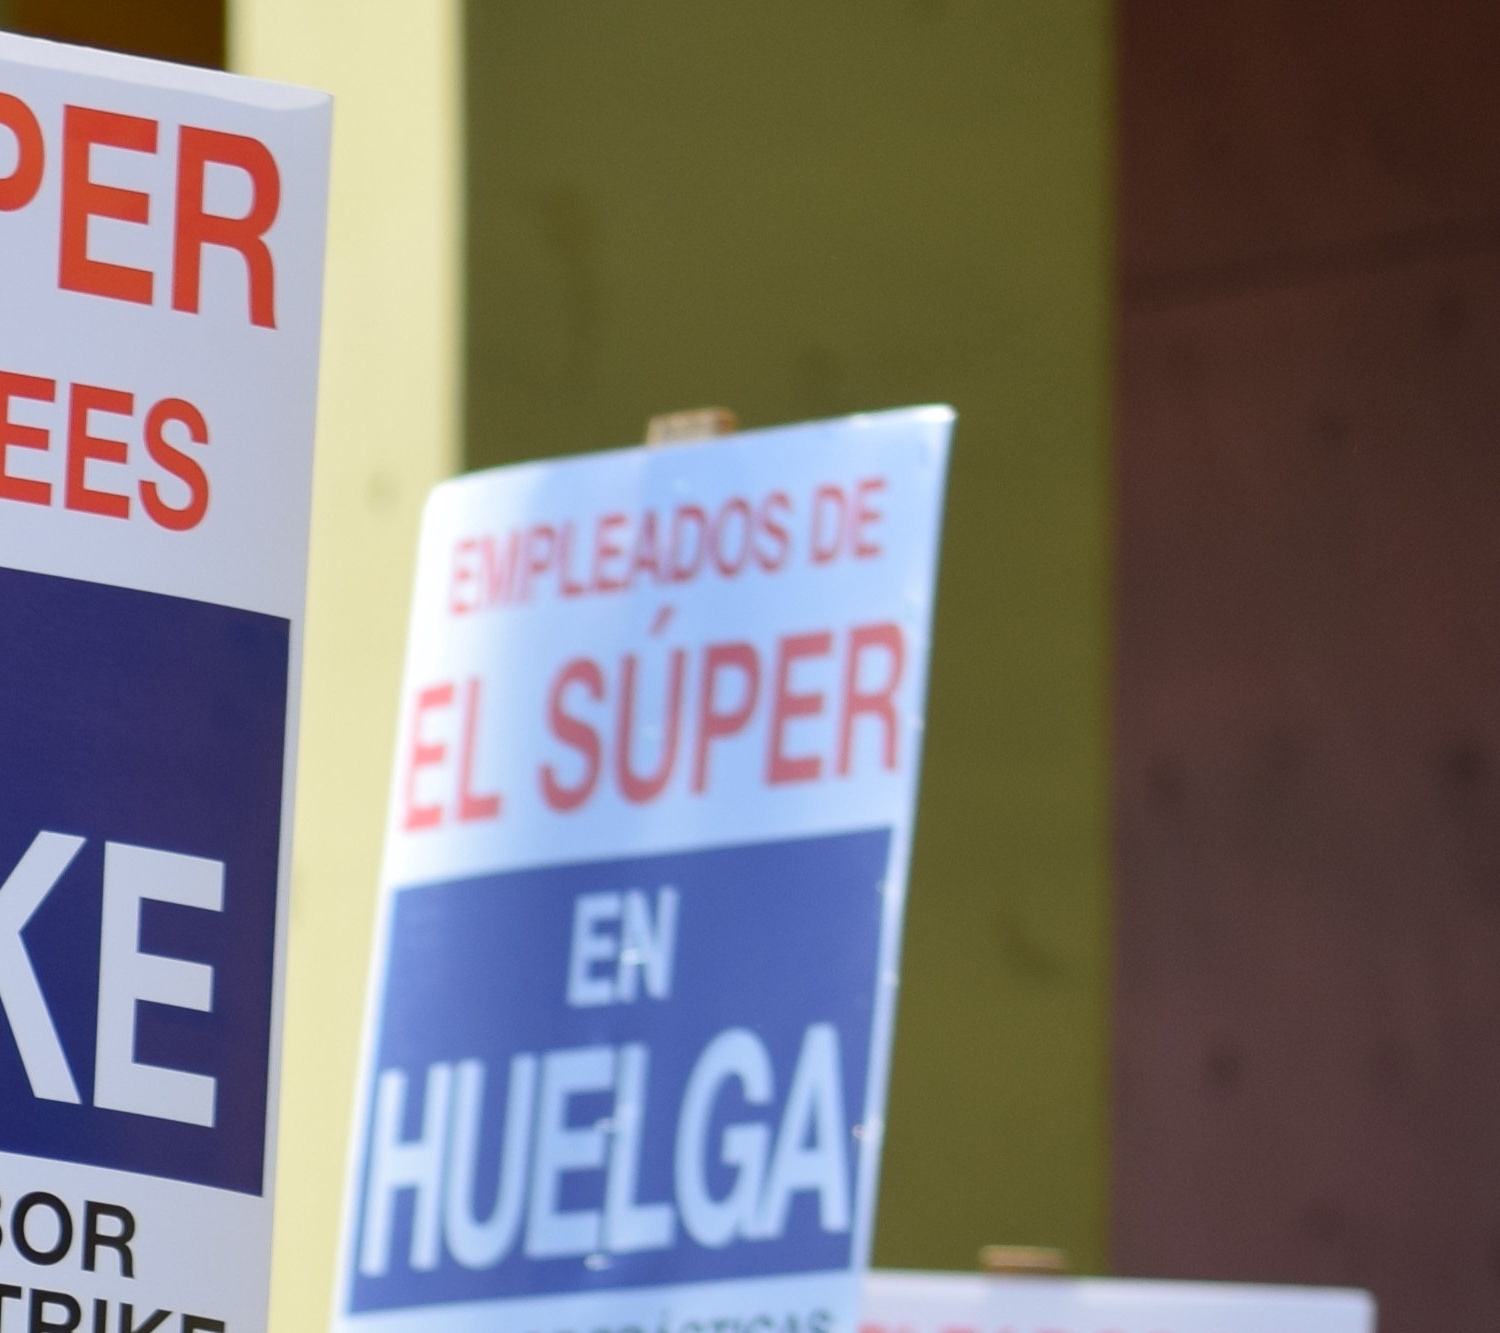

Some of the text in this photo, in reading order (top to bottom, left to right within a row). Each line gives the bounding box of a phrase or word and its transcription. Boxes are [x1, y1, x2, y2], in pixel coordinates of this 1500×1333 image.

[450, 477, 887, 614] EMPLEADOS DE
[402, 605, 909, 833] EL SÚPER
[566, 885, 679, 1007] EN
[359, 1021, 851, 1277] HUELGA
